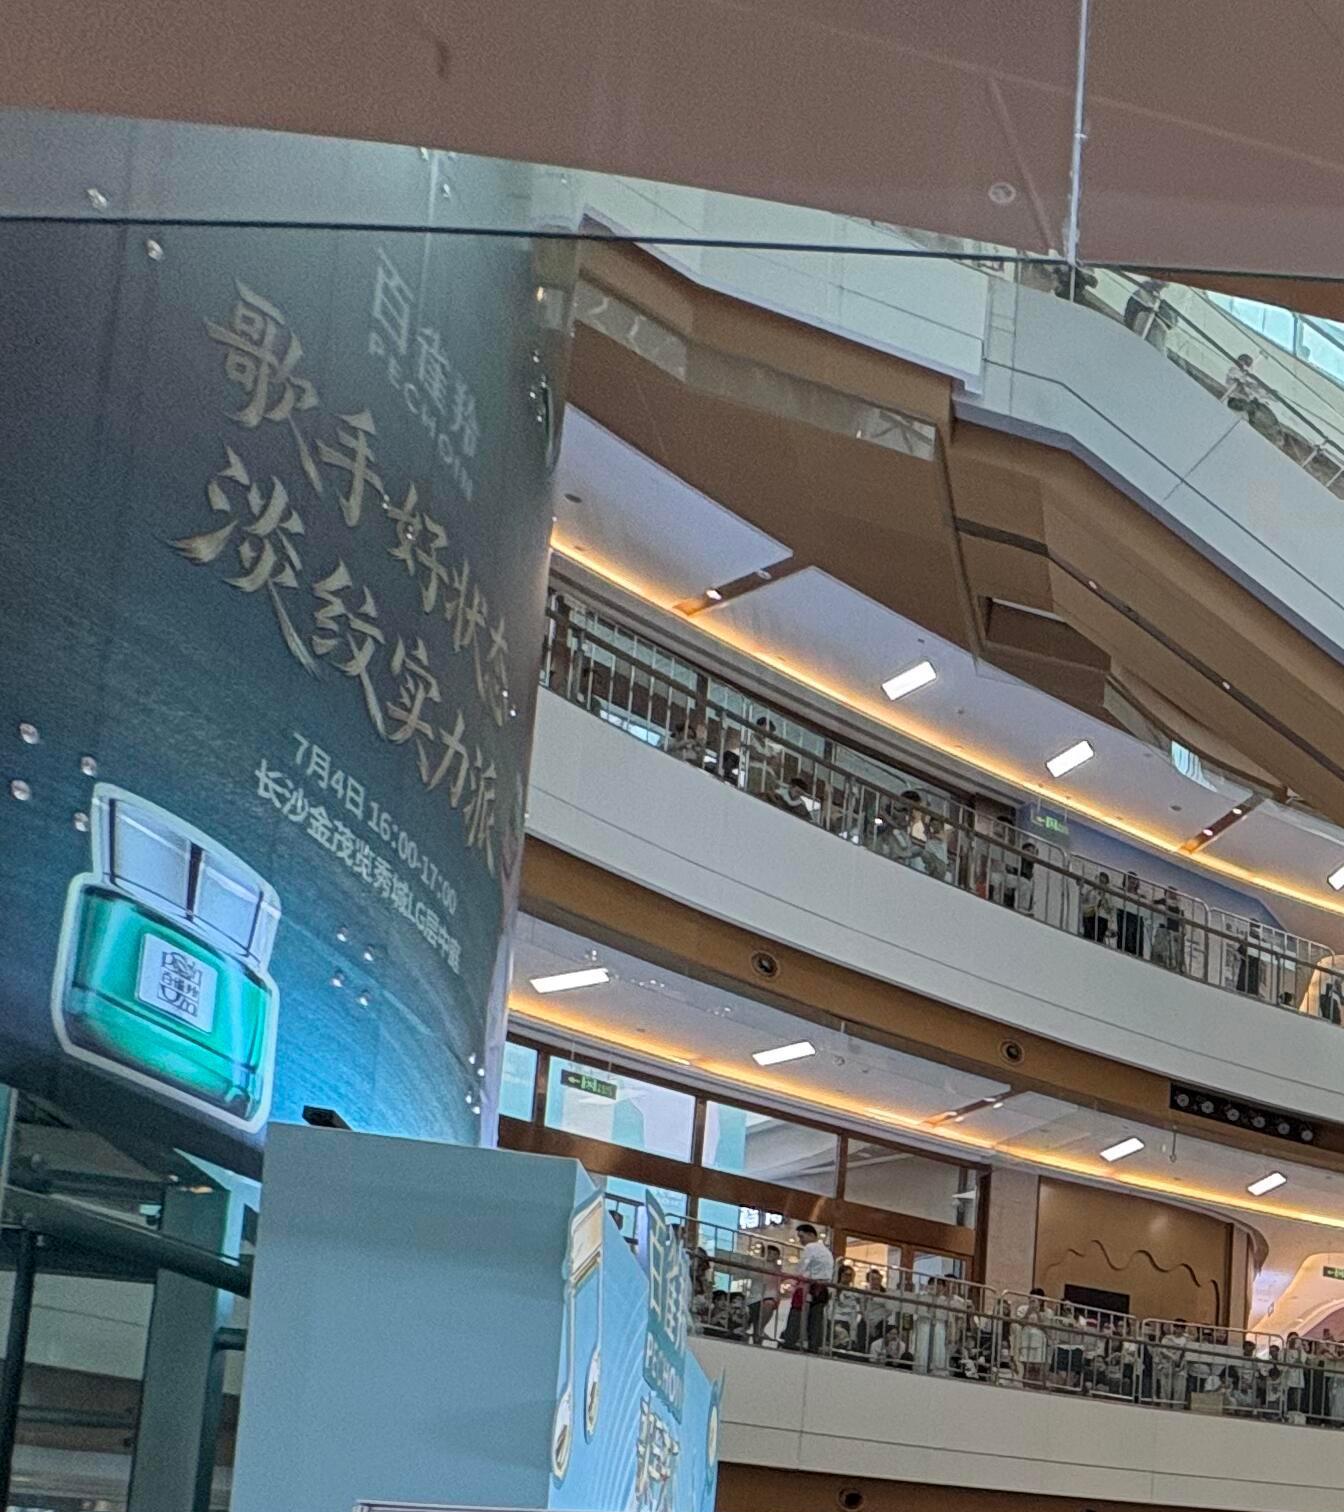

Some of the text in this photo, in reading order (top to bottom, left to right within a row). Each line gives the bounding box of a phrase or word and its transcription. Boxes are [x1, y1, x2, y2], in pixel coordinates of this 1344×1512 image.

[164, 443, 499, 877] 淡纹实力派
[294, 732, 457, 914] 7月4日 16:00-17:00
